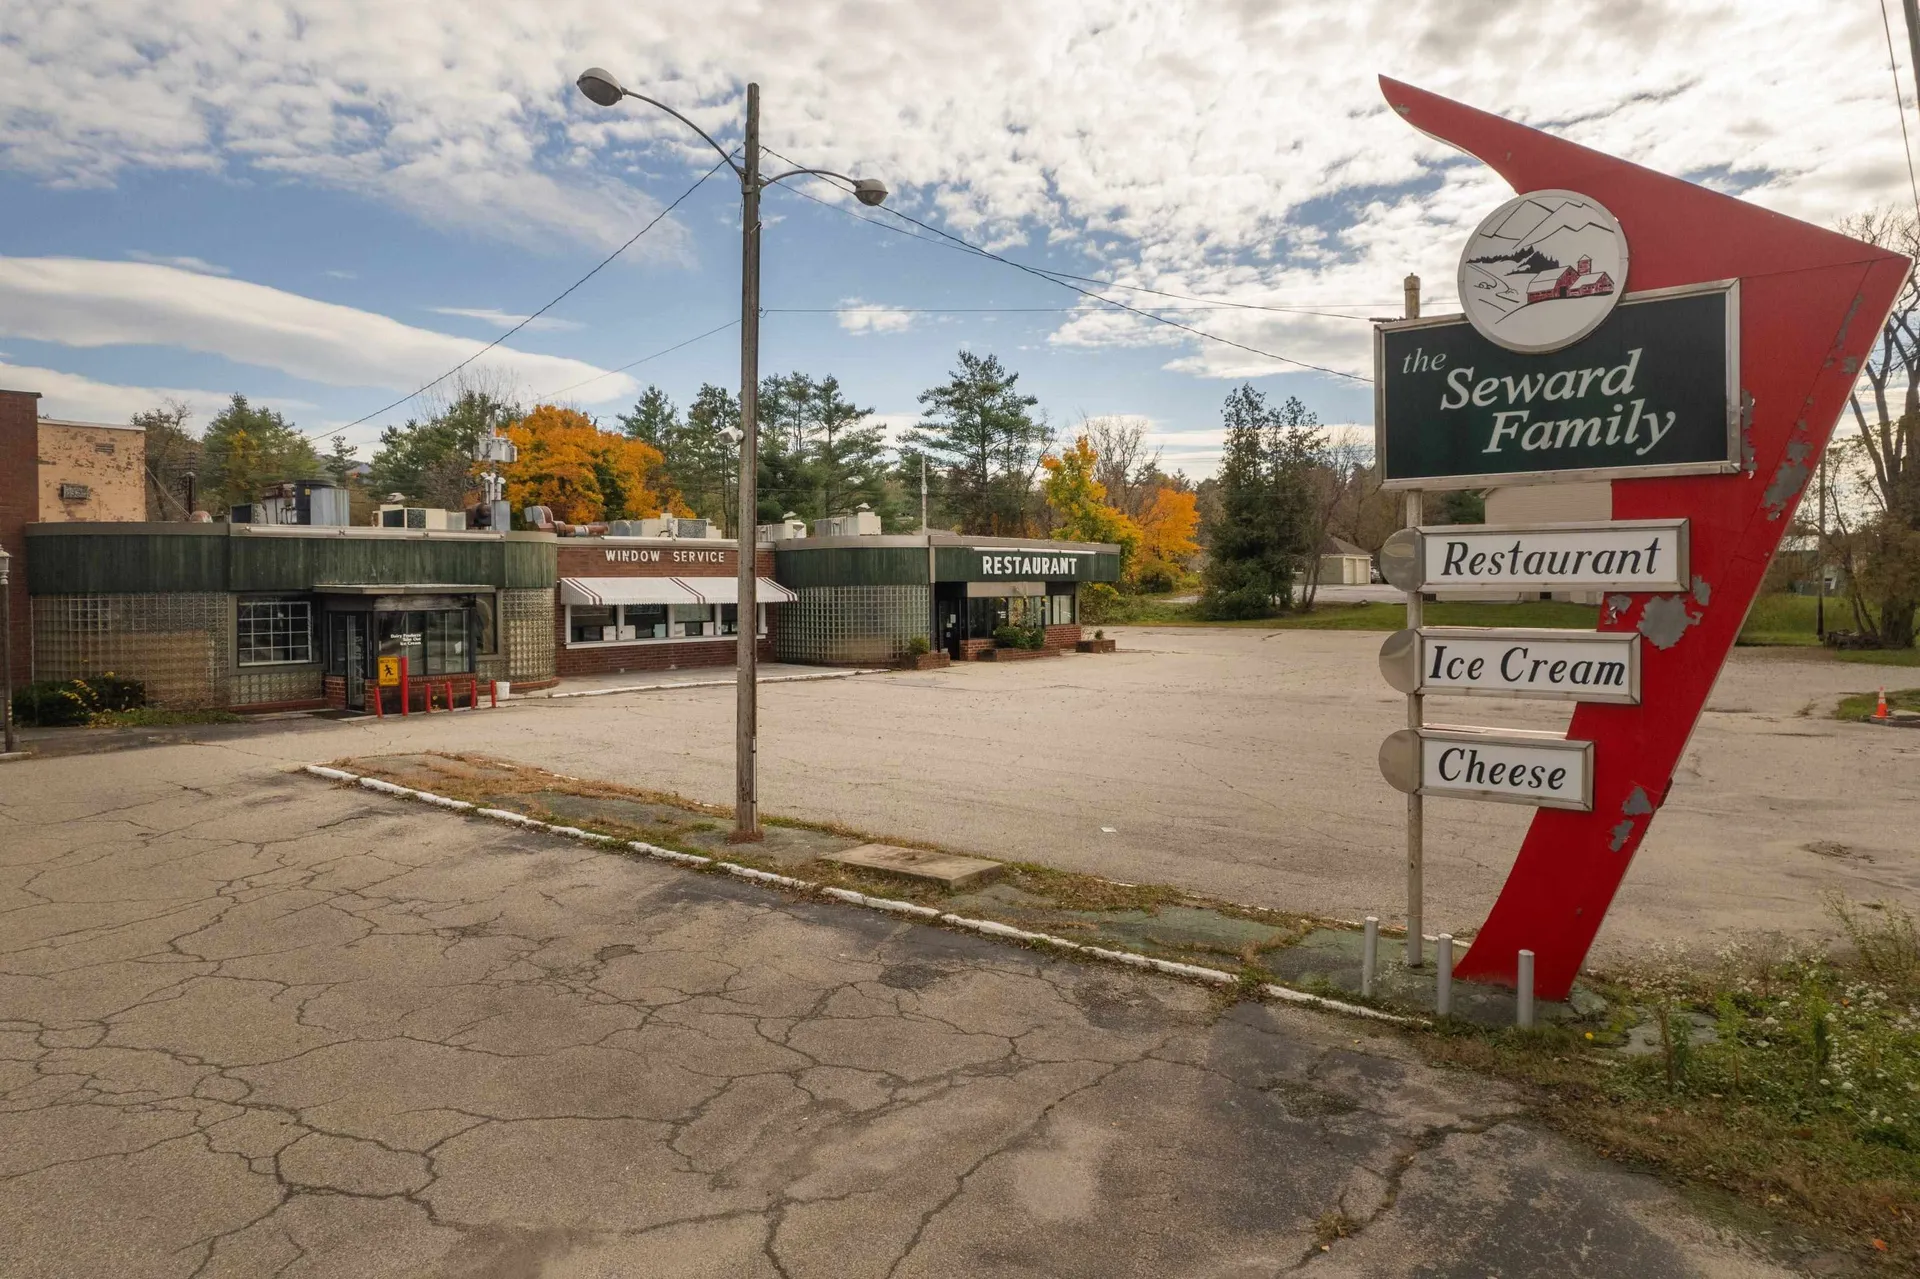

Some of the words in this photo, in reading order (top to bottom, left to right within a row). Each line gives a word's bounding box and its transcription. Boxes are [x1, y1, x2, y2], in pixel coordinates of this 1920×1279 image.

[1402, 347, 1447, 374] the
[1440, 347, 1643, 411] Seward
[1481, 398, 1677, 456] Family
[605, 550, 660, 562] WINDOW
[673, 551, 725, 563] SERVICE
[982, 555, 1077, 575] RESTAURANT
[1441, 537, 1662, 577] Restaurant
[1428, 645, 1485, 680] Ice
[1500, 646, 1626, 686] Cream
[1437, 746, 1567, 790] Cheese
